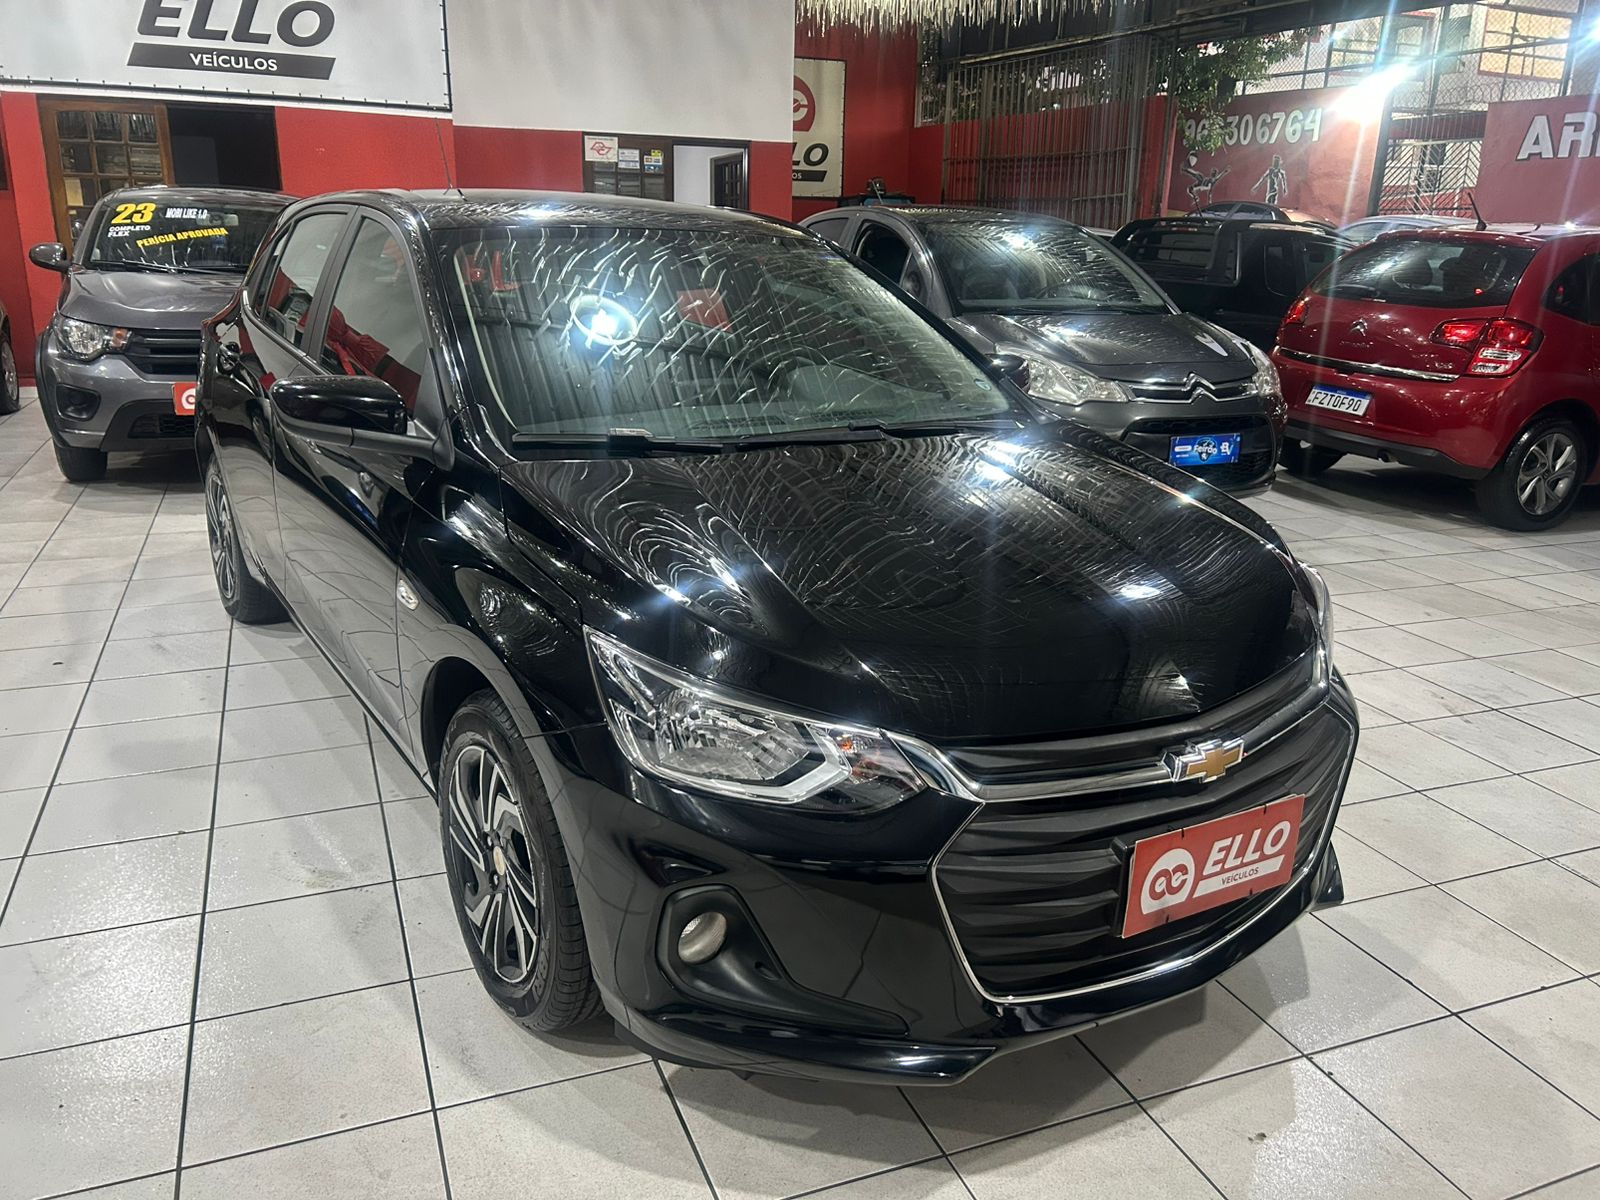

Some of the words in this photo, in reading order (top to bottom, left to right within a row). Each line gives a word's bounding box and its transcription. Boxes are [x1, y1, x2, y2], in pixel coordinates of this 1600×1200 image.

[137, 0, 335, 47] ELLO
[189, 52, 278, 71] VEÍCULOS
[1516, 111, 1600, 160] AR
[111, 202, 156, 224] 23
[165, 207, 181, 218] MOBI
[182, 208, 197, 219] LIKE
[176, 227, 229, 241] APROVADA
[1203, 820, 1291, 876] ELLO
[1221, 866, 1259, 886] VEÍCULOS
